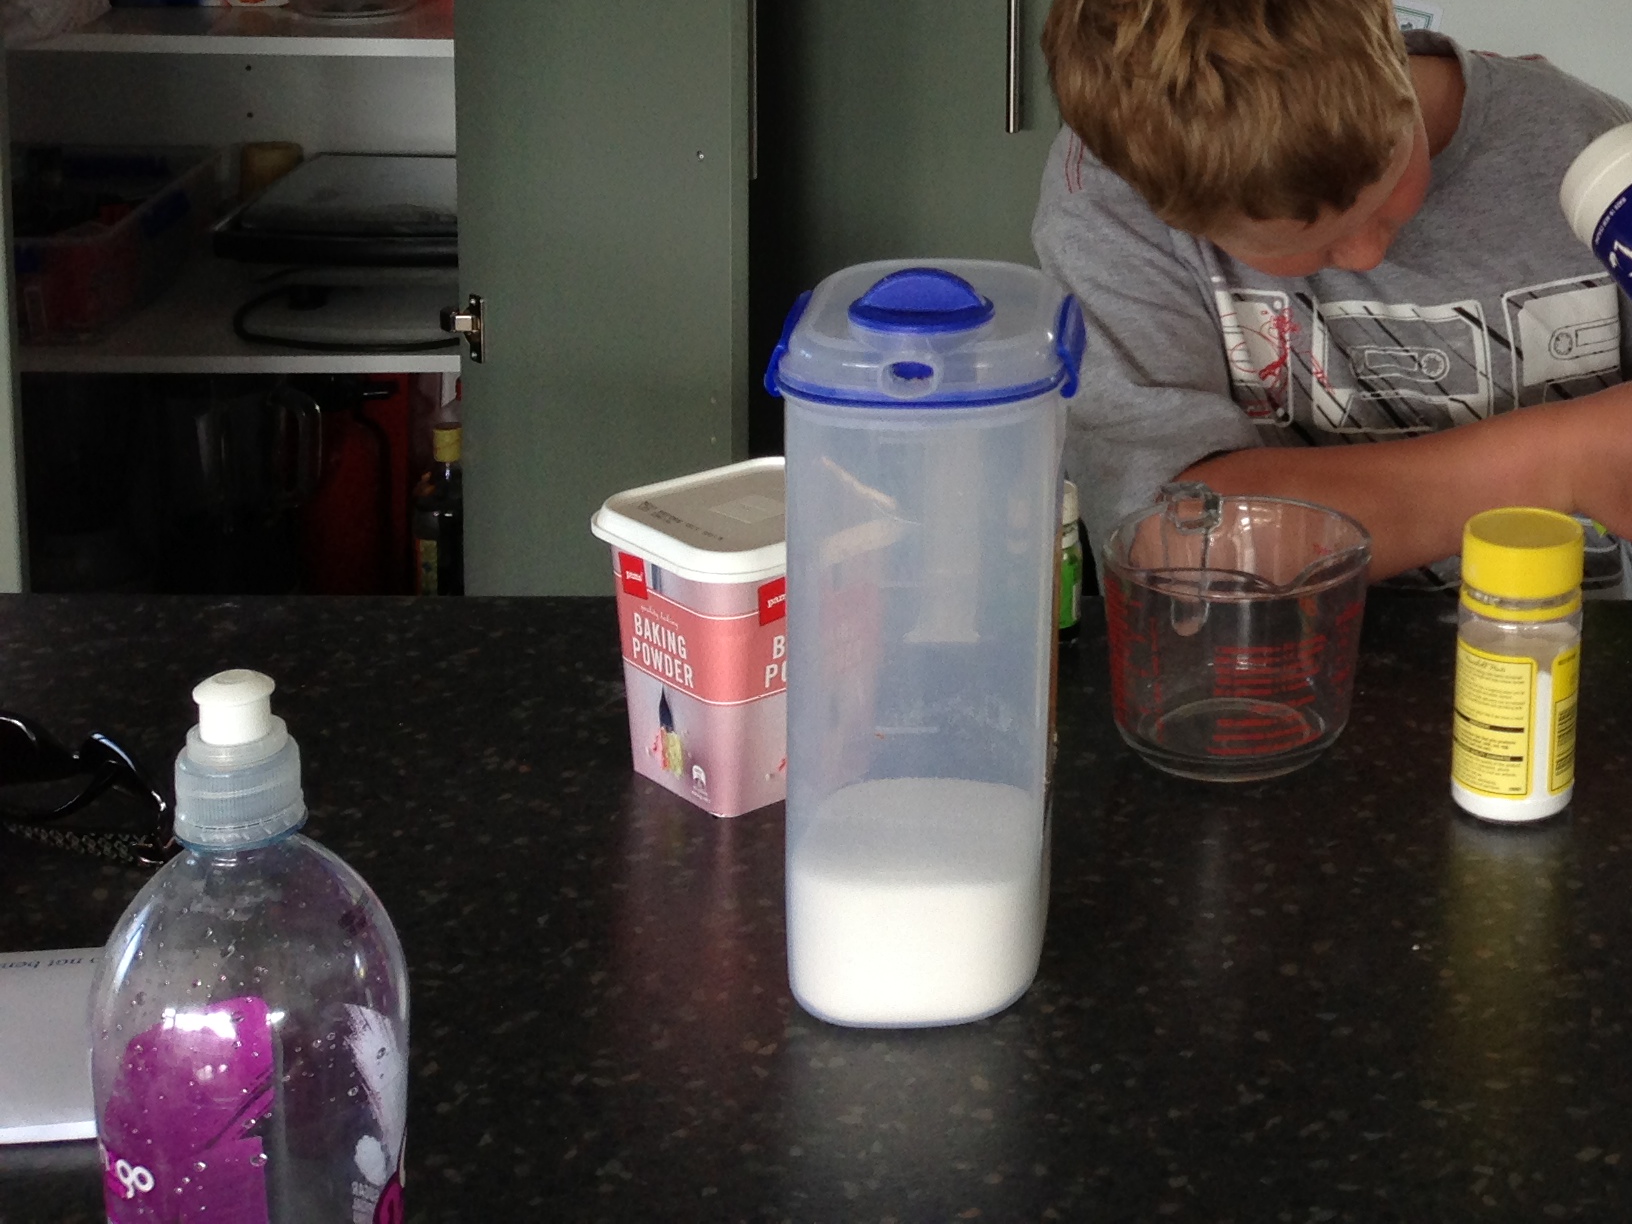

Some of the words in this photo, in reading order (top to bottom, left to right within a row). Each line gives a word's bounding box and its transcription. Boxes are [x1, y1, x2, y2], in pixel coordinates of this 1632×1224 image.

[767, 593, 786, 608] pam
[633, 612, 687, 660] BAKING
[632, 636, 694, 689] POWDER
[0, 960, 41, 970] ben
[114, 1158, 155, 1200] go
